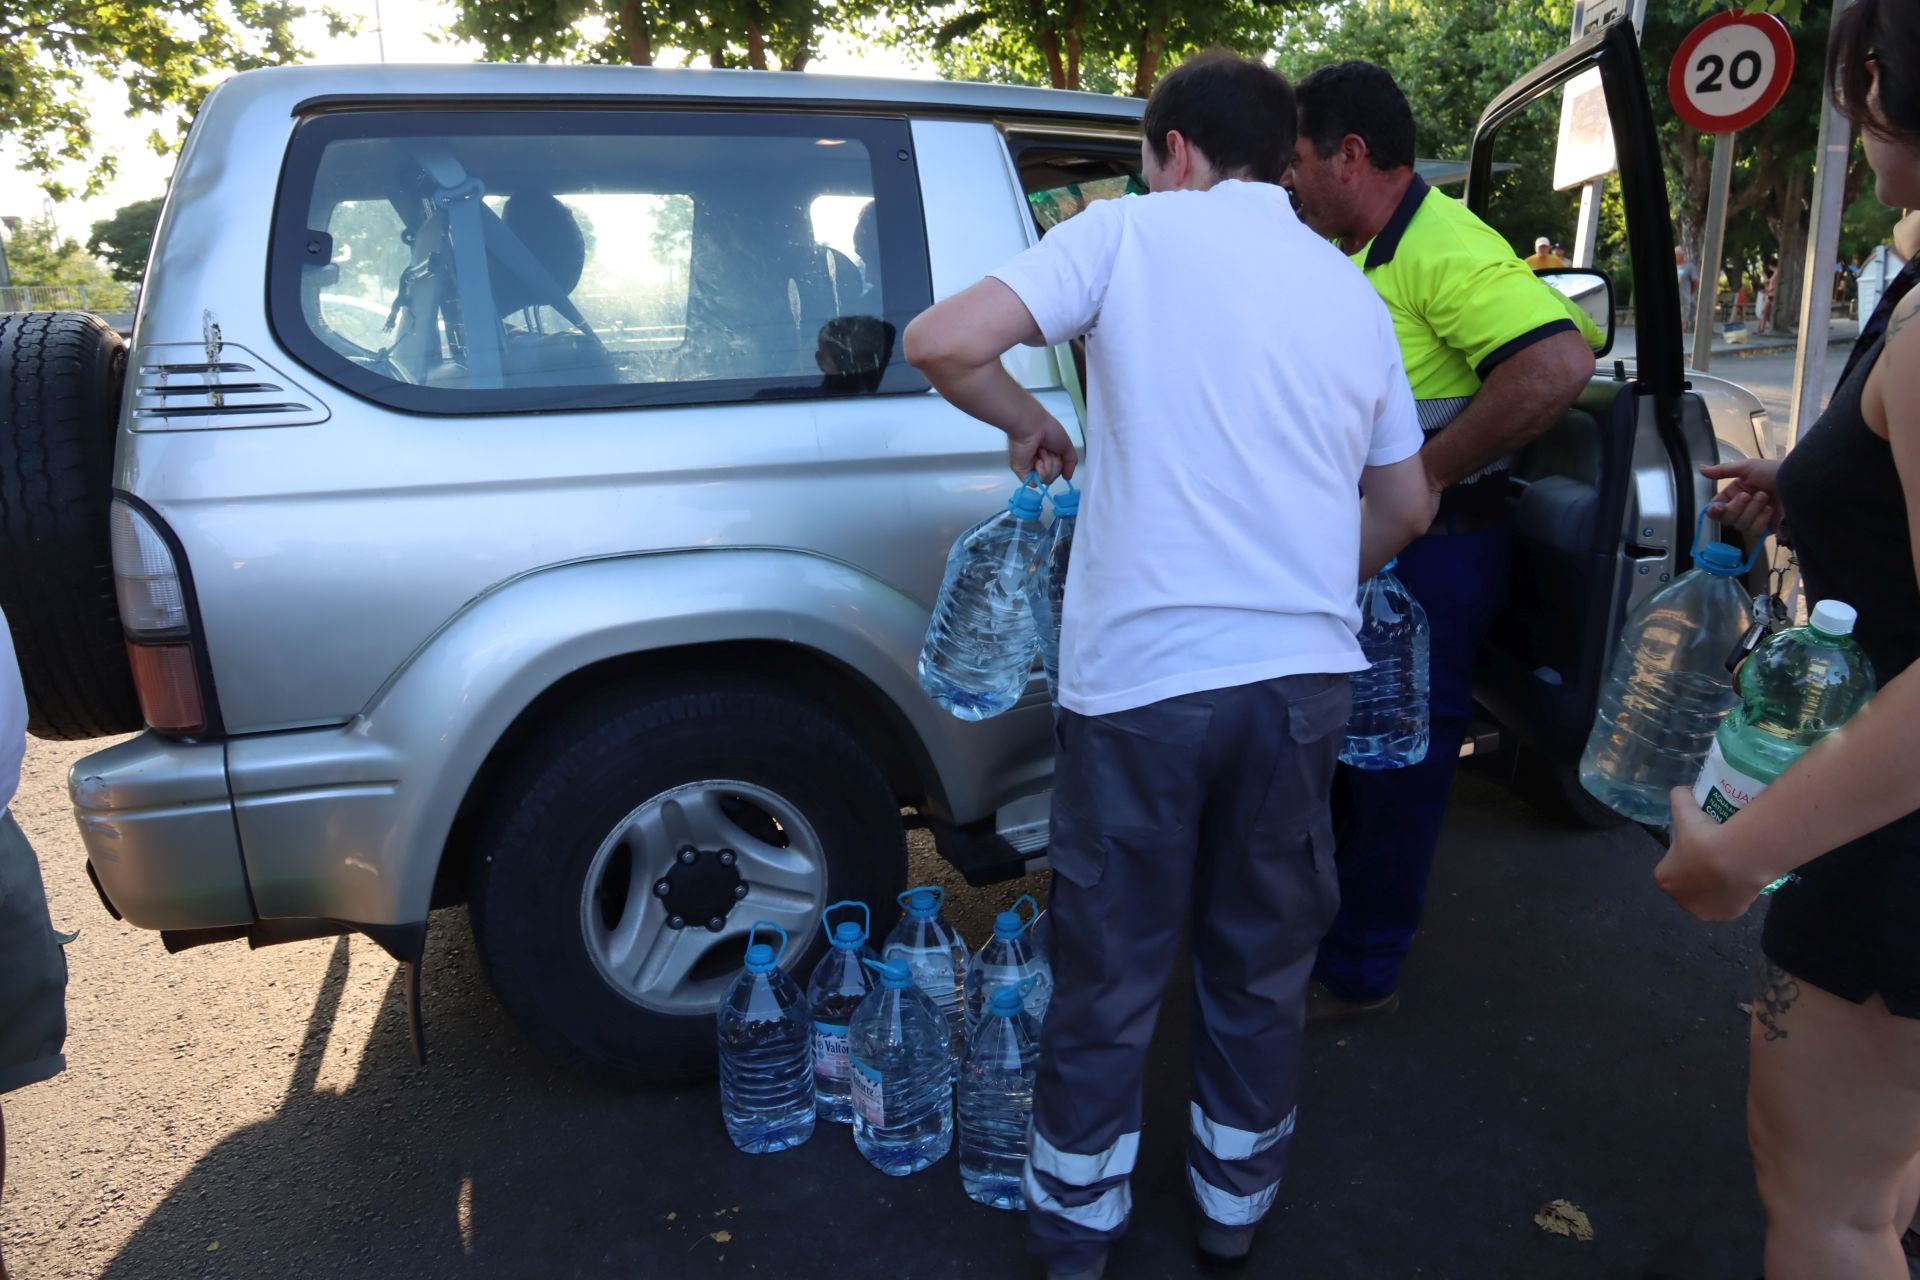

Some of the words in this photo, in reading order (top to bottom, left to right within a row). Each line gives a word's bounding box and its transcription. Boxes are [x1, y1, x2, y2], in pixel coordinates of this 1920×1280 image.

[1696, 50, 1762, 94] 20
[1720, 779, 1757, 804] AGUA
[1706, 805, 1723, 822] CON
[1709, 798, 1729, 818] NATUR
[825, 1039, 849, 1055] Valtor
